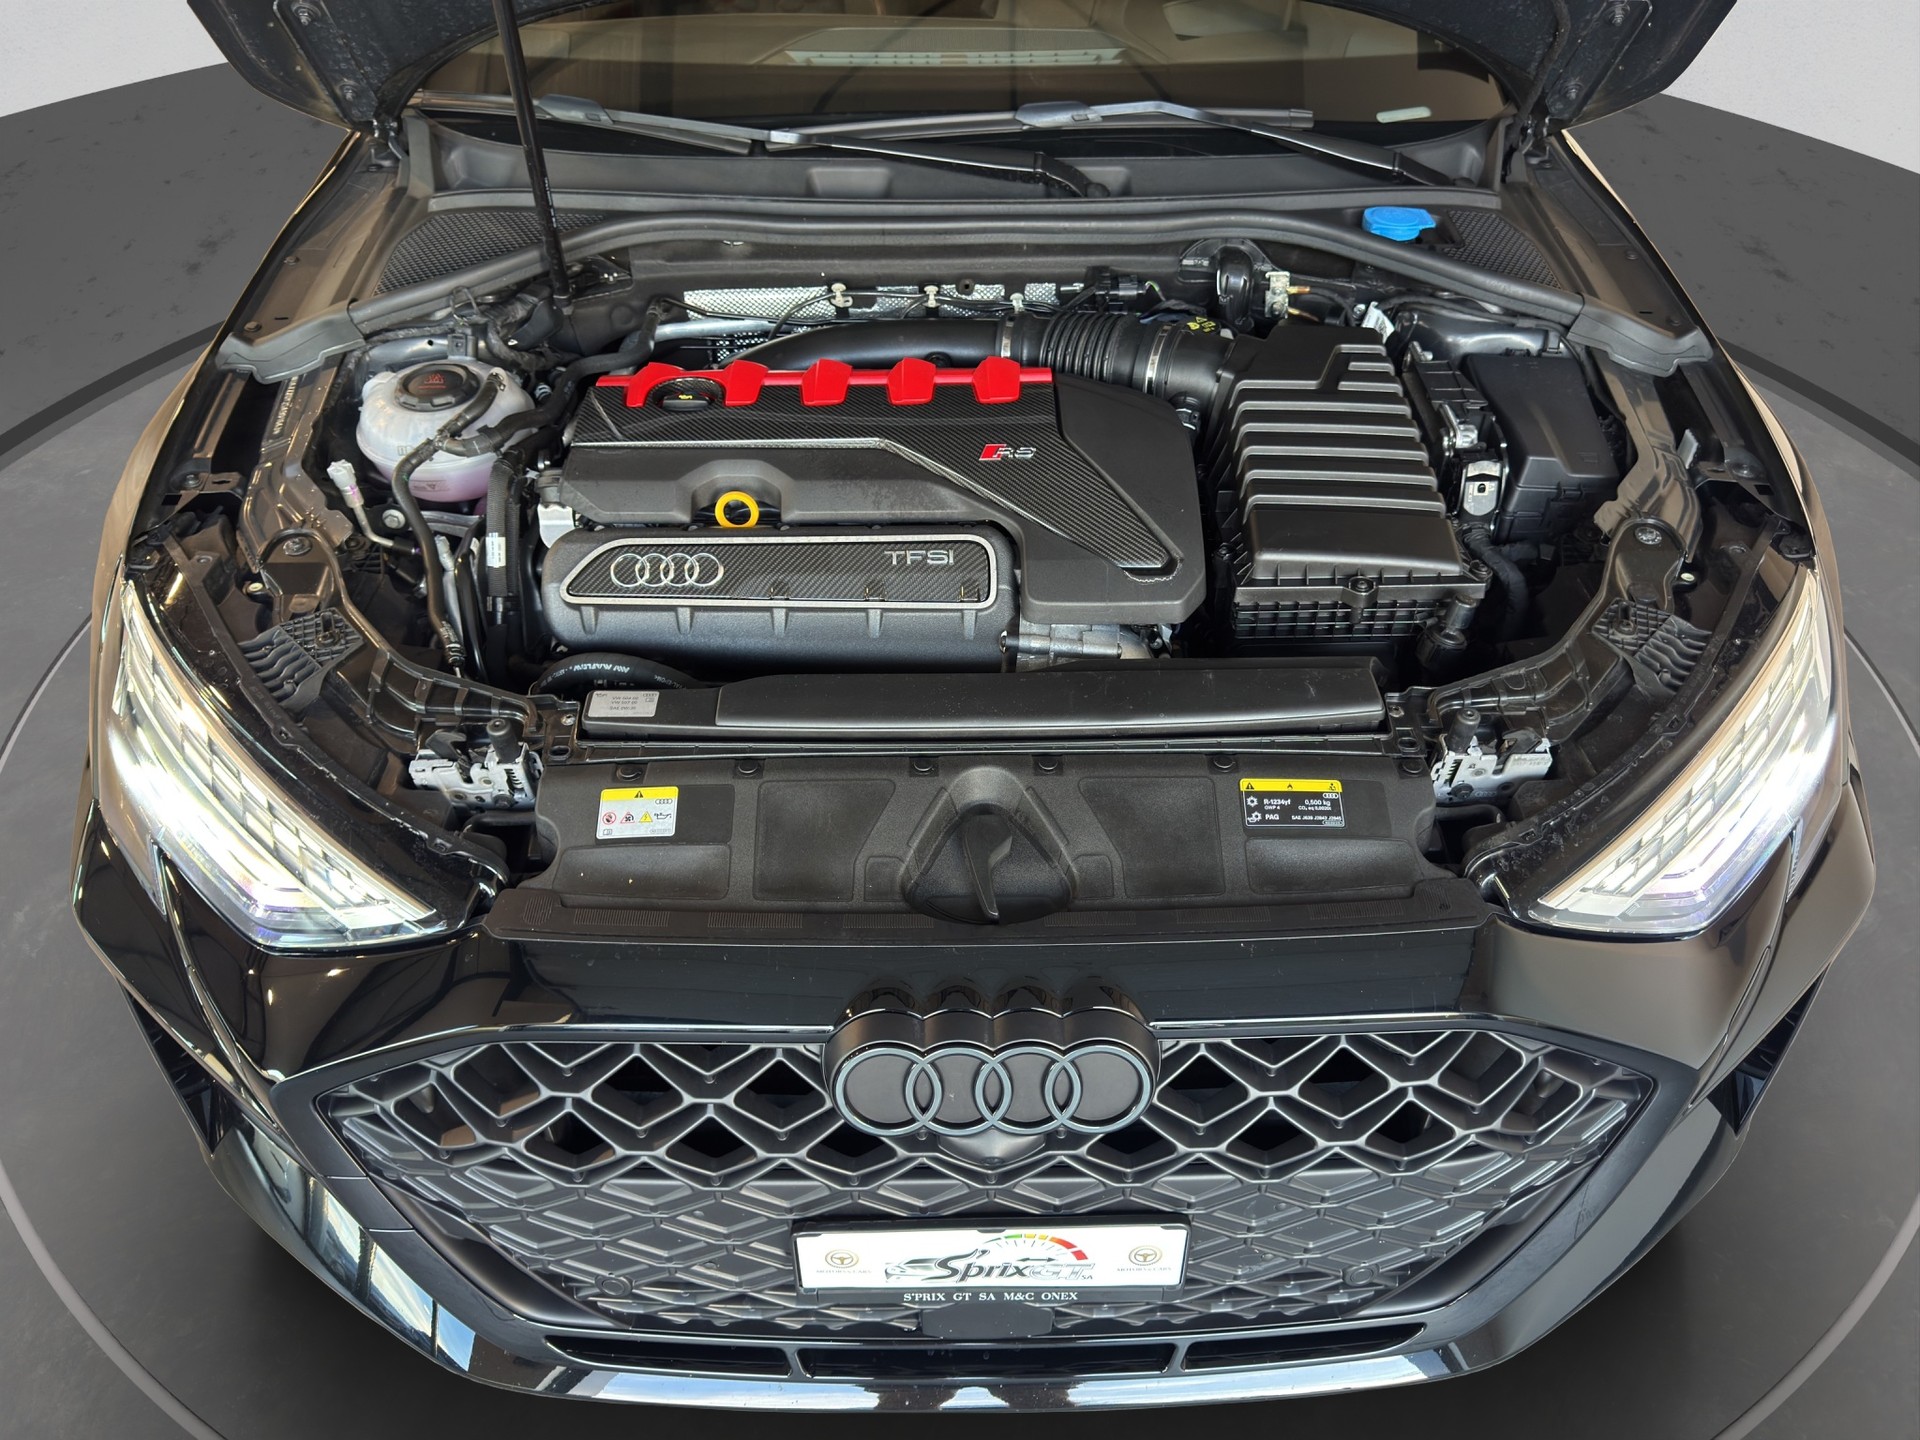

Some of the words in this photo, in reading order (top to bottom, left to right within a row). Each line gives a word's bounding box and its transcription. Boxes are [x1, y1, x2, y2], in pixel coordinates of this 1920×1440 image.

[990, 446, 1037, 460] RS
[883, 549, 954, 565] TFSI
[1263, 798, 1291, 806] R-1234yf
[1323, 799, 1331, 807] kg
[953, 1292, 972, 1302] GT
[978, 1292, 996, 1302] SA
[1003, 1292, 1035, 1302] M&C
[1041, 1292, 1078, 1302] ONEX
